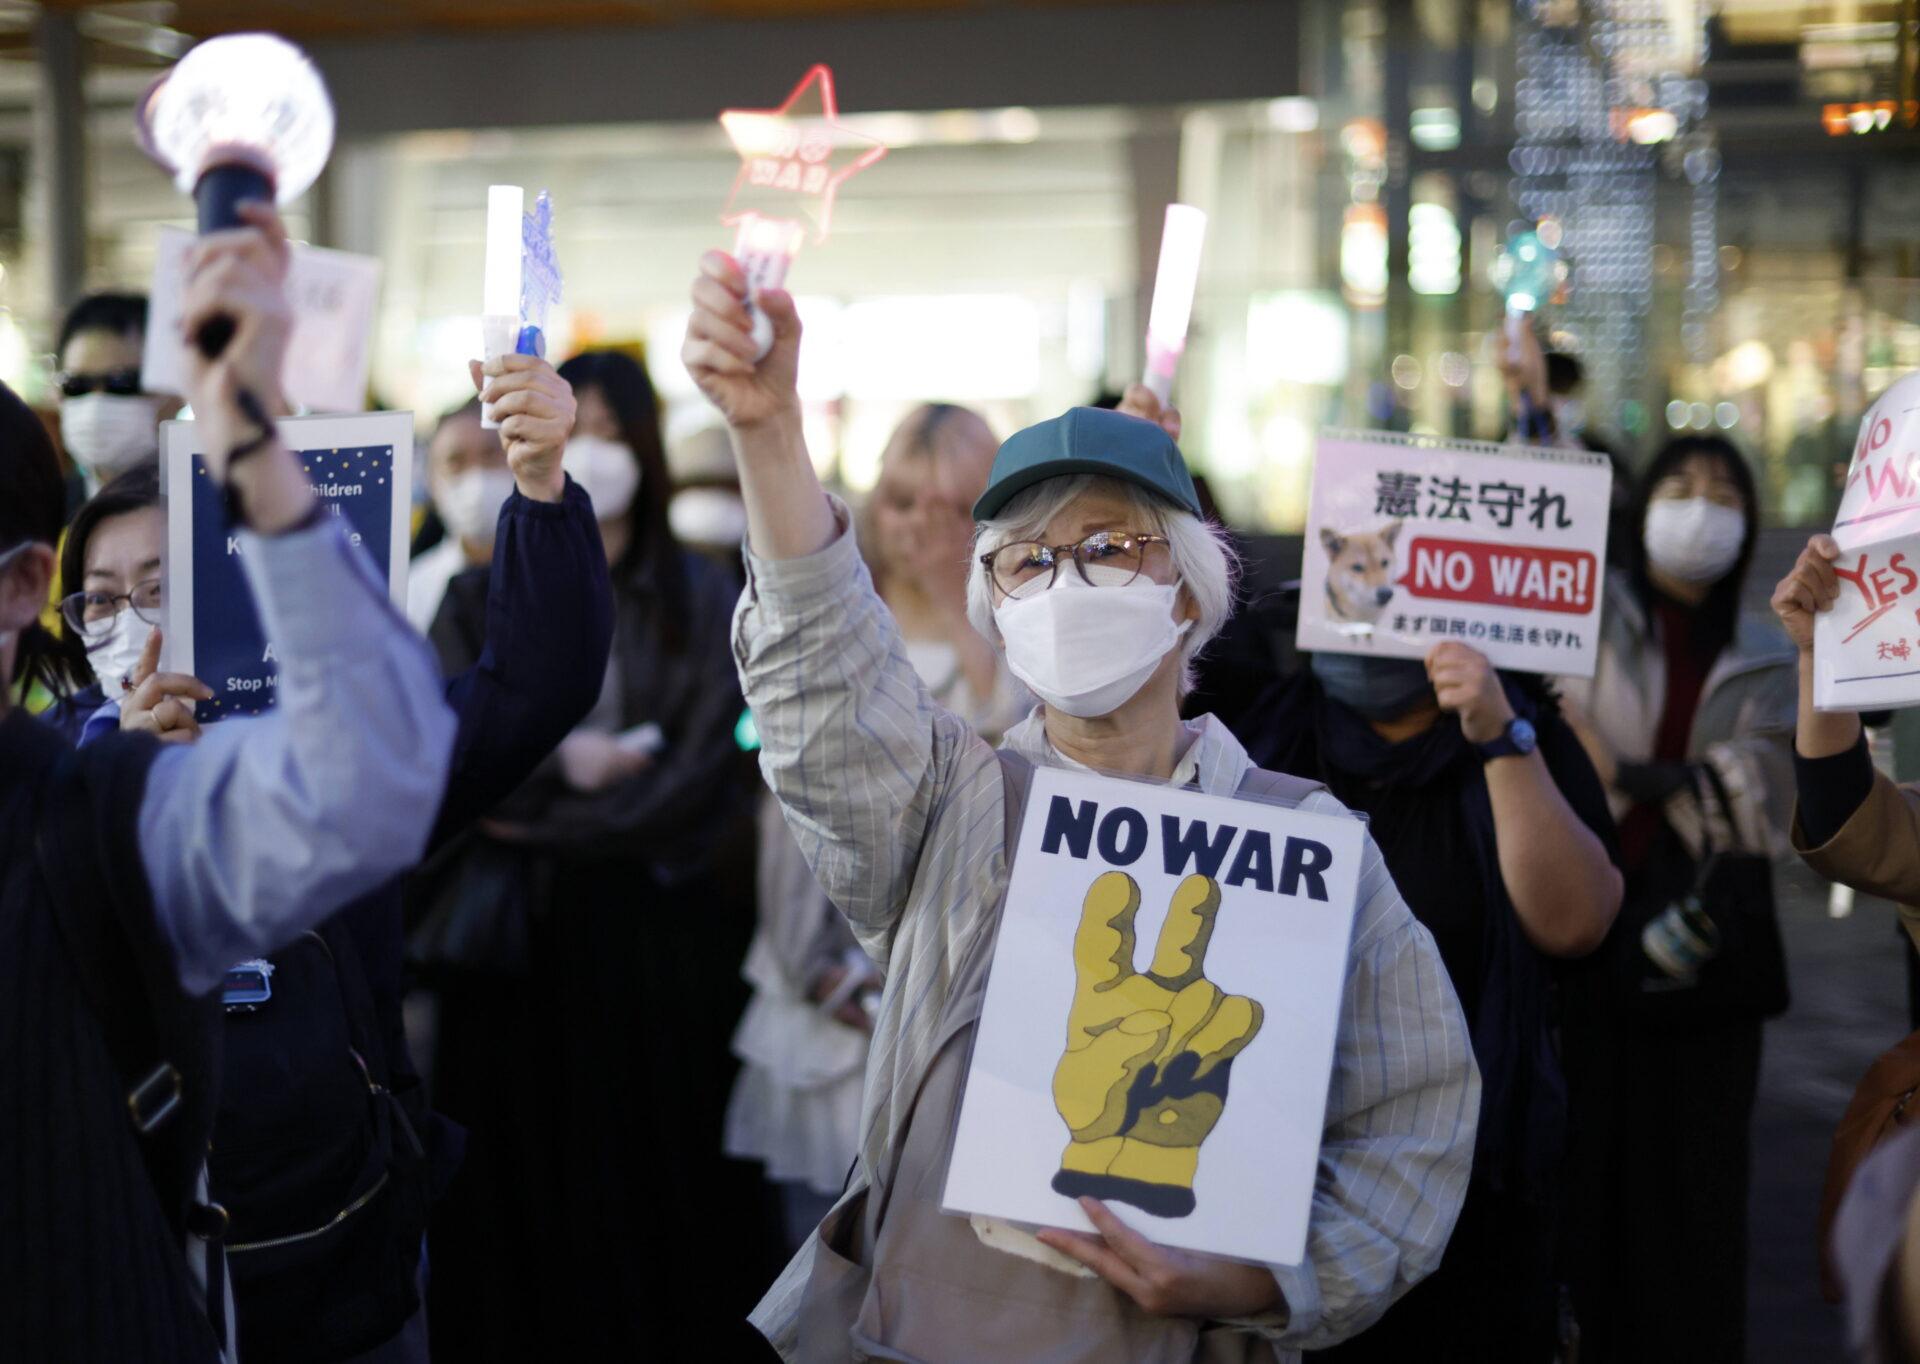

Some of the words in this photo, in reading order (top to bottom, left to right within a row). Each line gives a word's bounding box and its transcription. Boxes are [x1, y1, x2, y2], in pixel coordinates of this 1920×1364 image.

[1374, 471, 1573, 530] 憲法守れ
[1414, 547, 1475, 592] NO
[1489, 555, 1590, 605] WAR!
[1833, 553, 1918, 611] YES
[1393, 614, 1583, 649] まず国民の生活を守れ
[226, 677, 263, 693] Stop
[1040, 795, 1149, 867] NO
[1160, 813, 1333, 902] WAR
